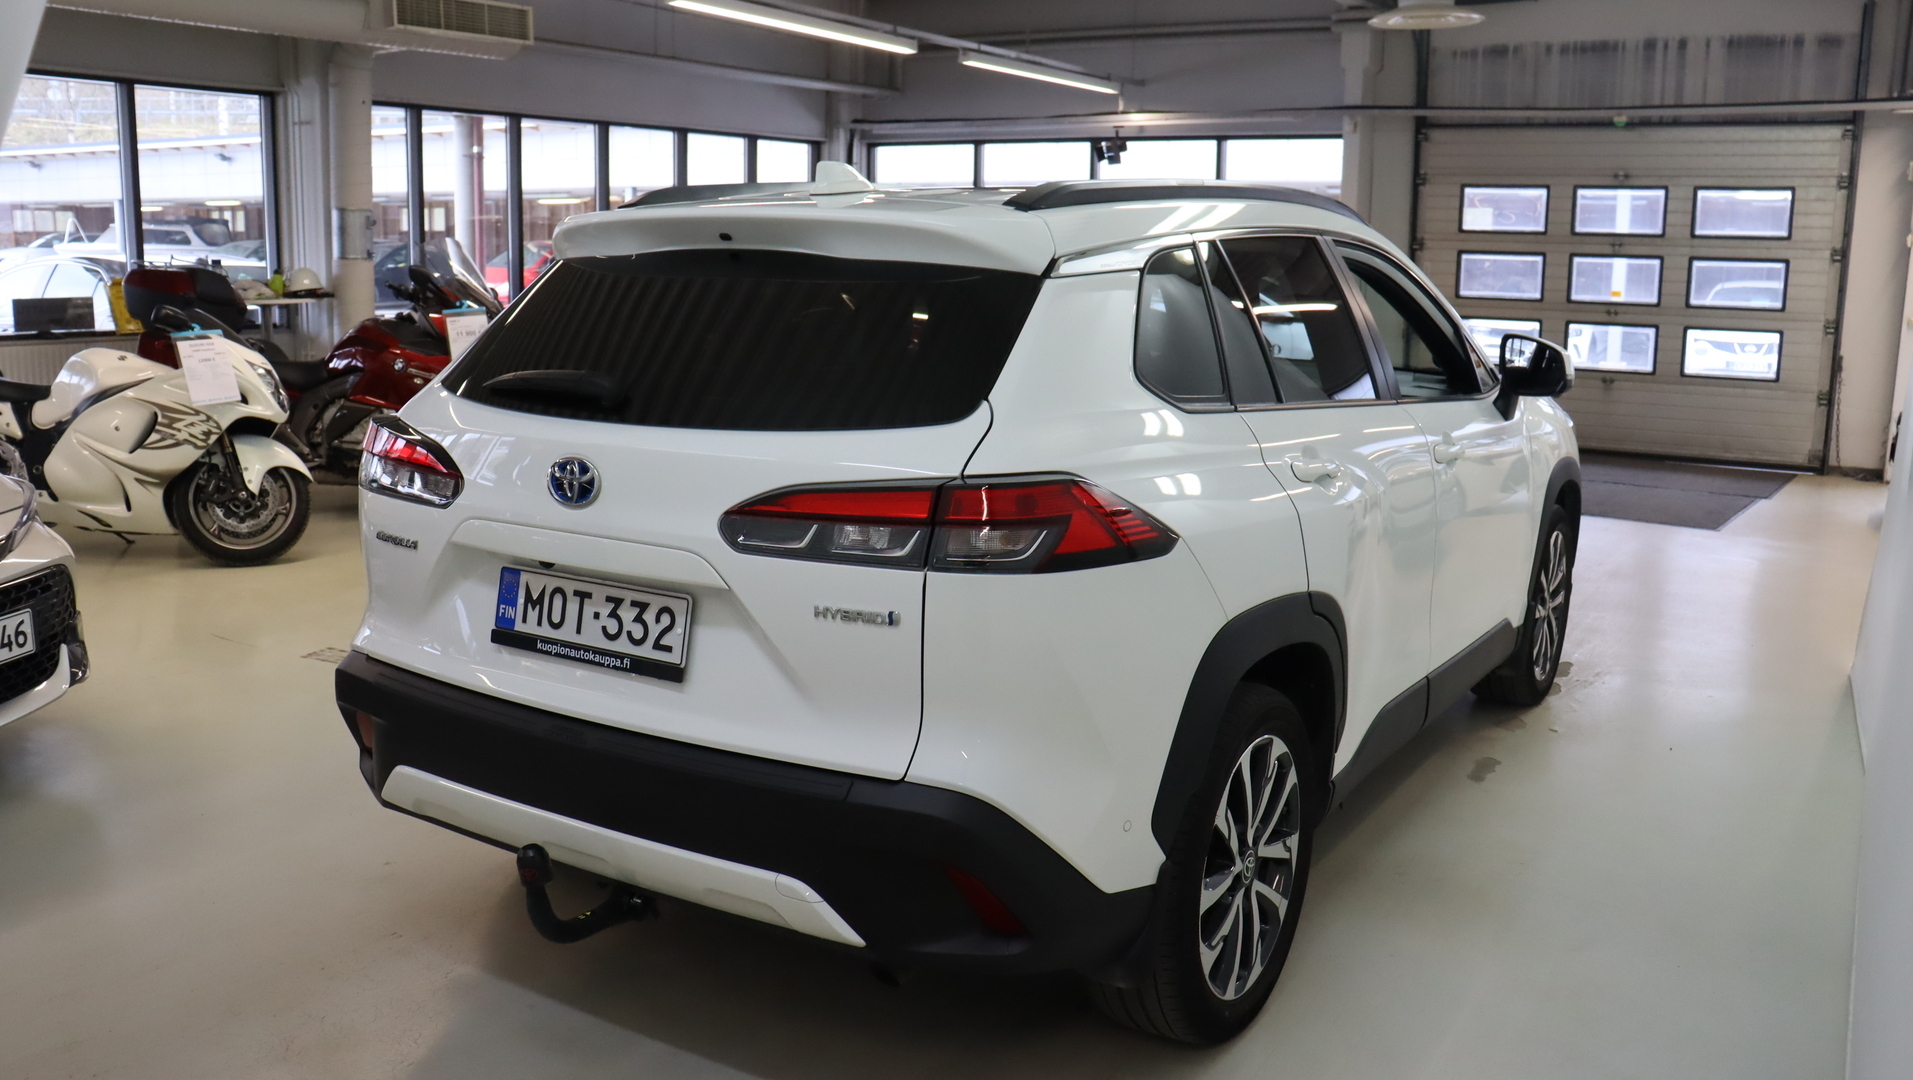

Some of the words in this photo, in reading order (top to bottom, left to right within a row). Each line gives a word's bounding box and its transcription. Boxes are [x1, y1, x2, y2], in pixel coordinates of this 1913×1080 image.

[499, 604, 516, 620] FIN
[521, 581, 673, 653] MOT-332
[813, 604, 887, 626] HYBRID
[0, 618, 28, 653] 46
[536, 639, 631, 669] kuopionautokauppa.fi
